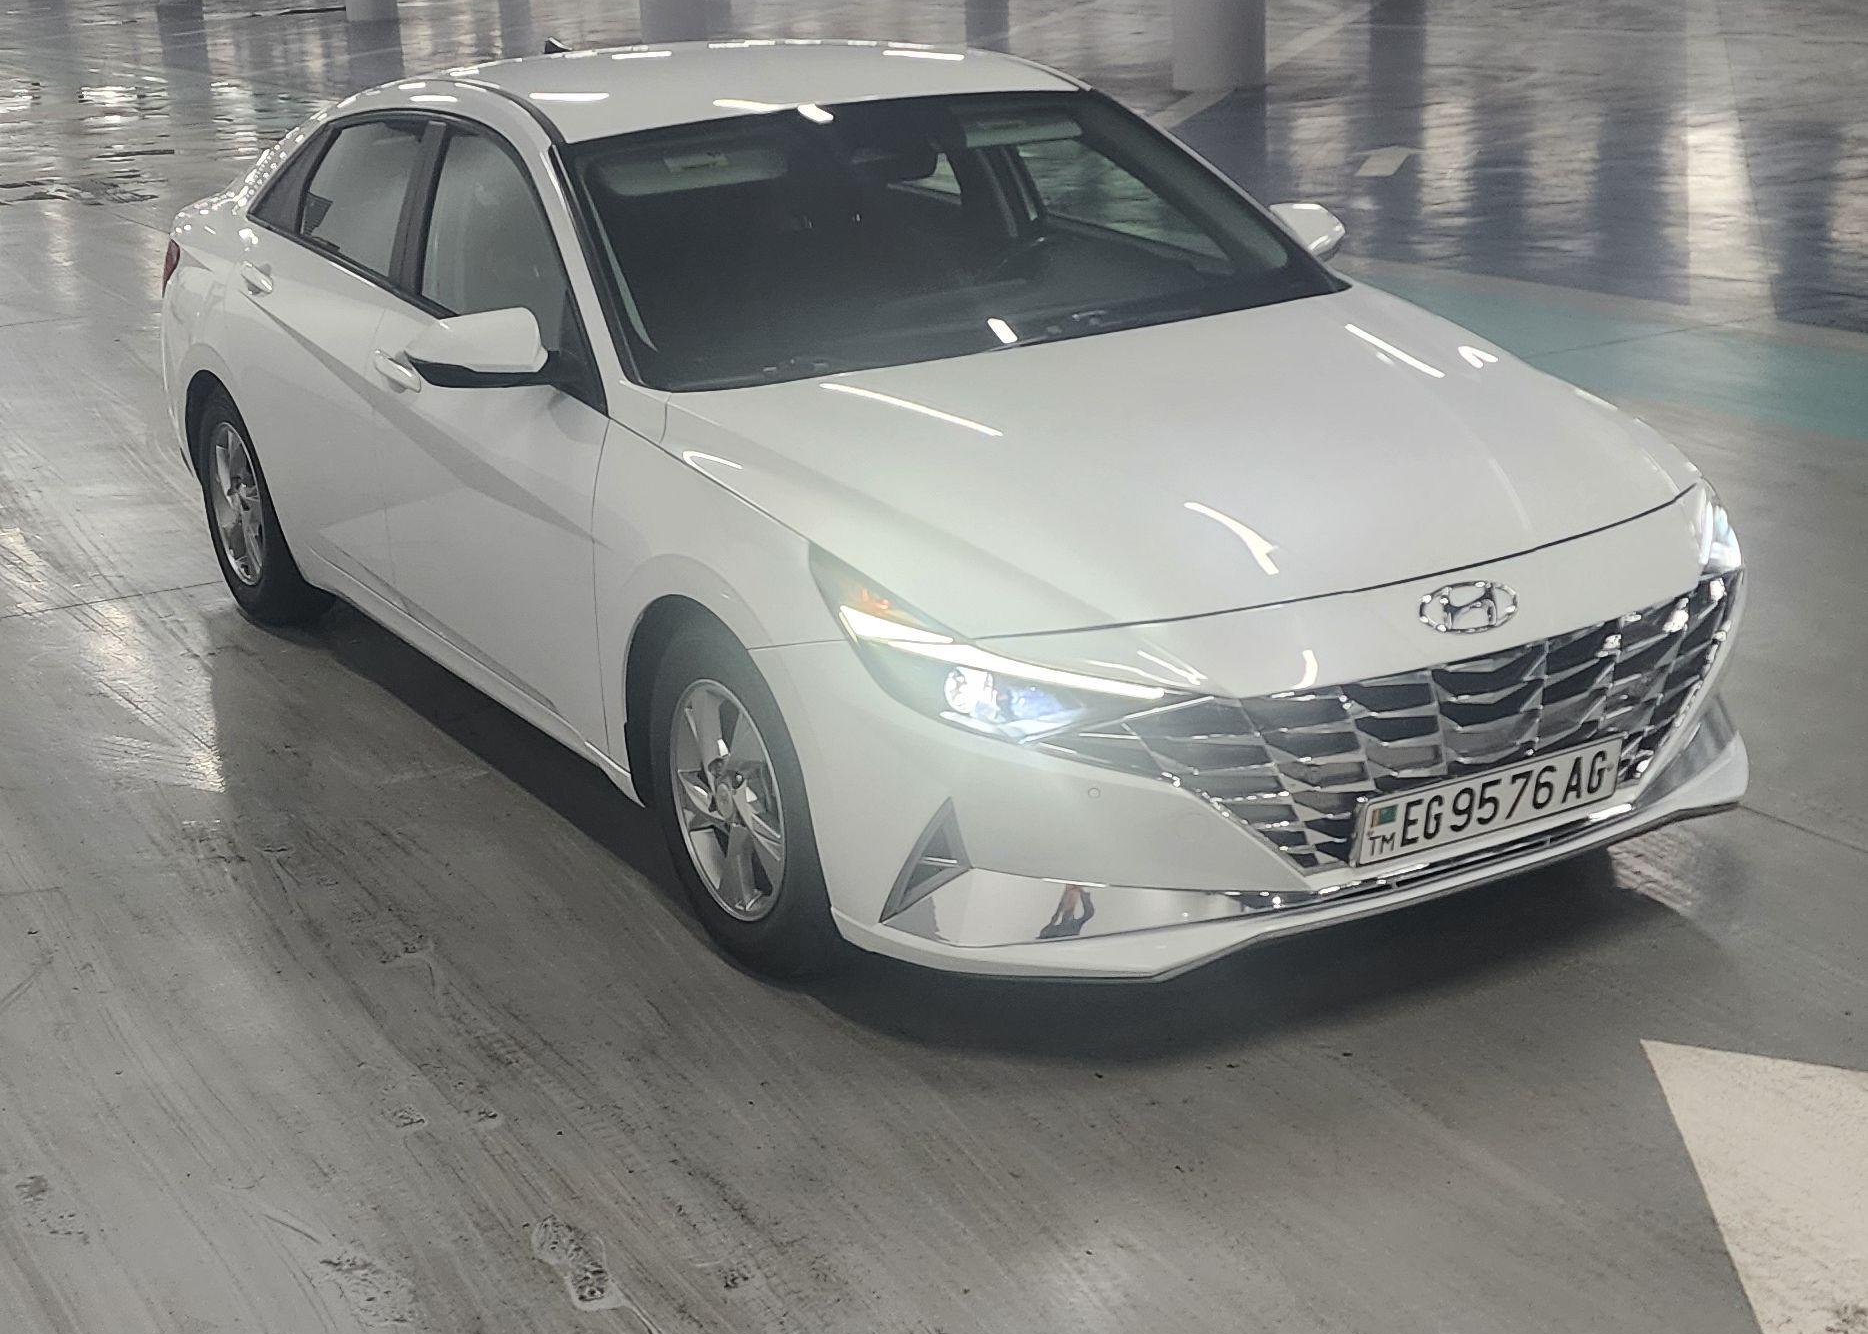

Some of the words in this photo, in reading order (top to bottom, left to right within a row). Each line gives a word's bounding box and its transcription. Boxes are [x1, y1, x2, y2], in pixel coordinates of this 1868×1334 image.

[1450, 765, 1557, 833] 9576
[1561, 750, 1608, 804] AG
[1367, 832, 1396, 857] TM
